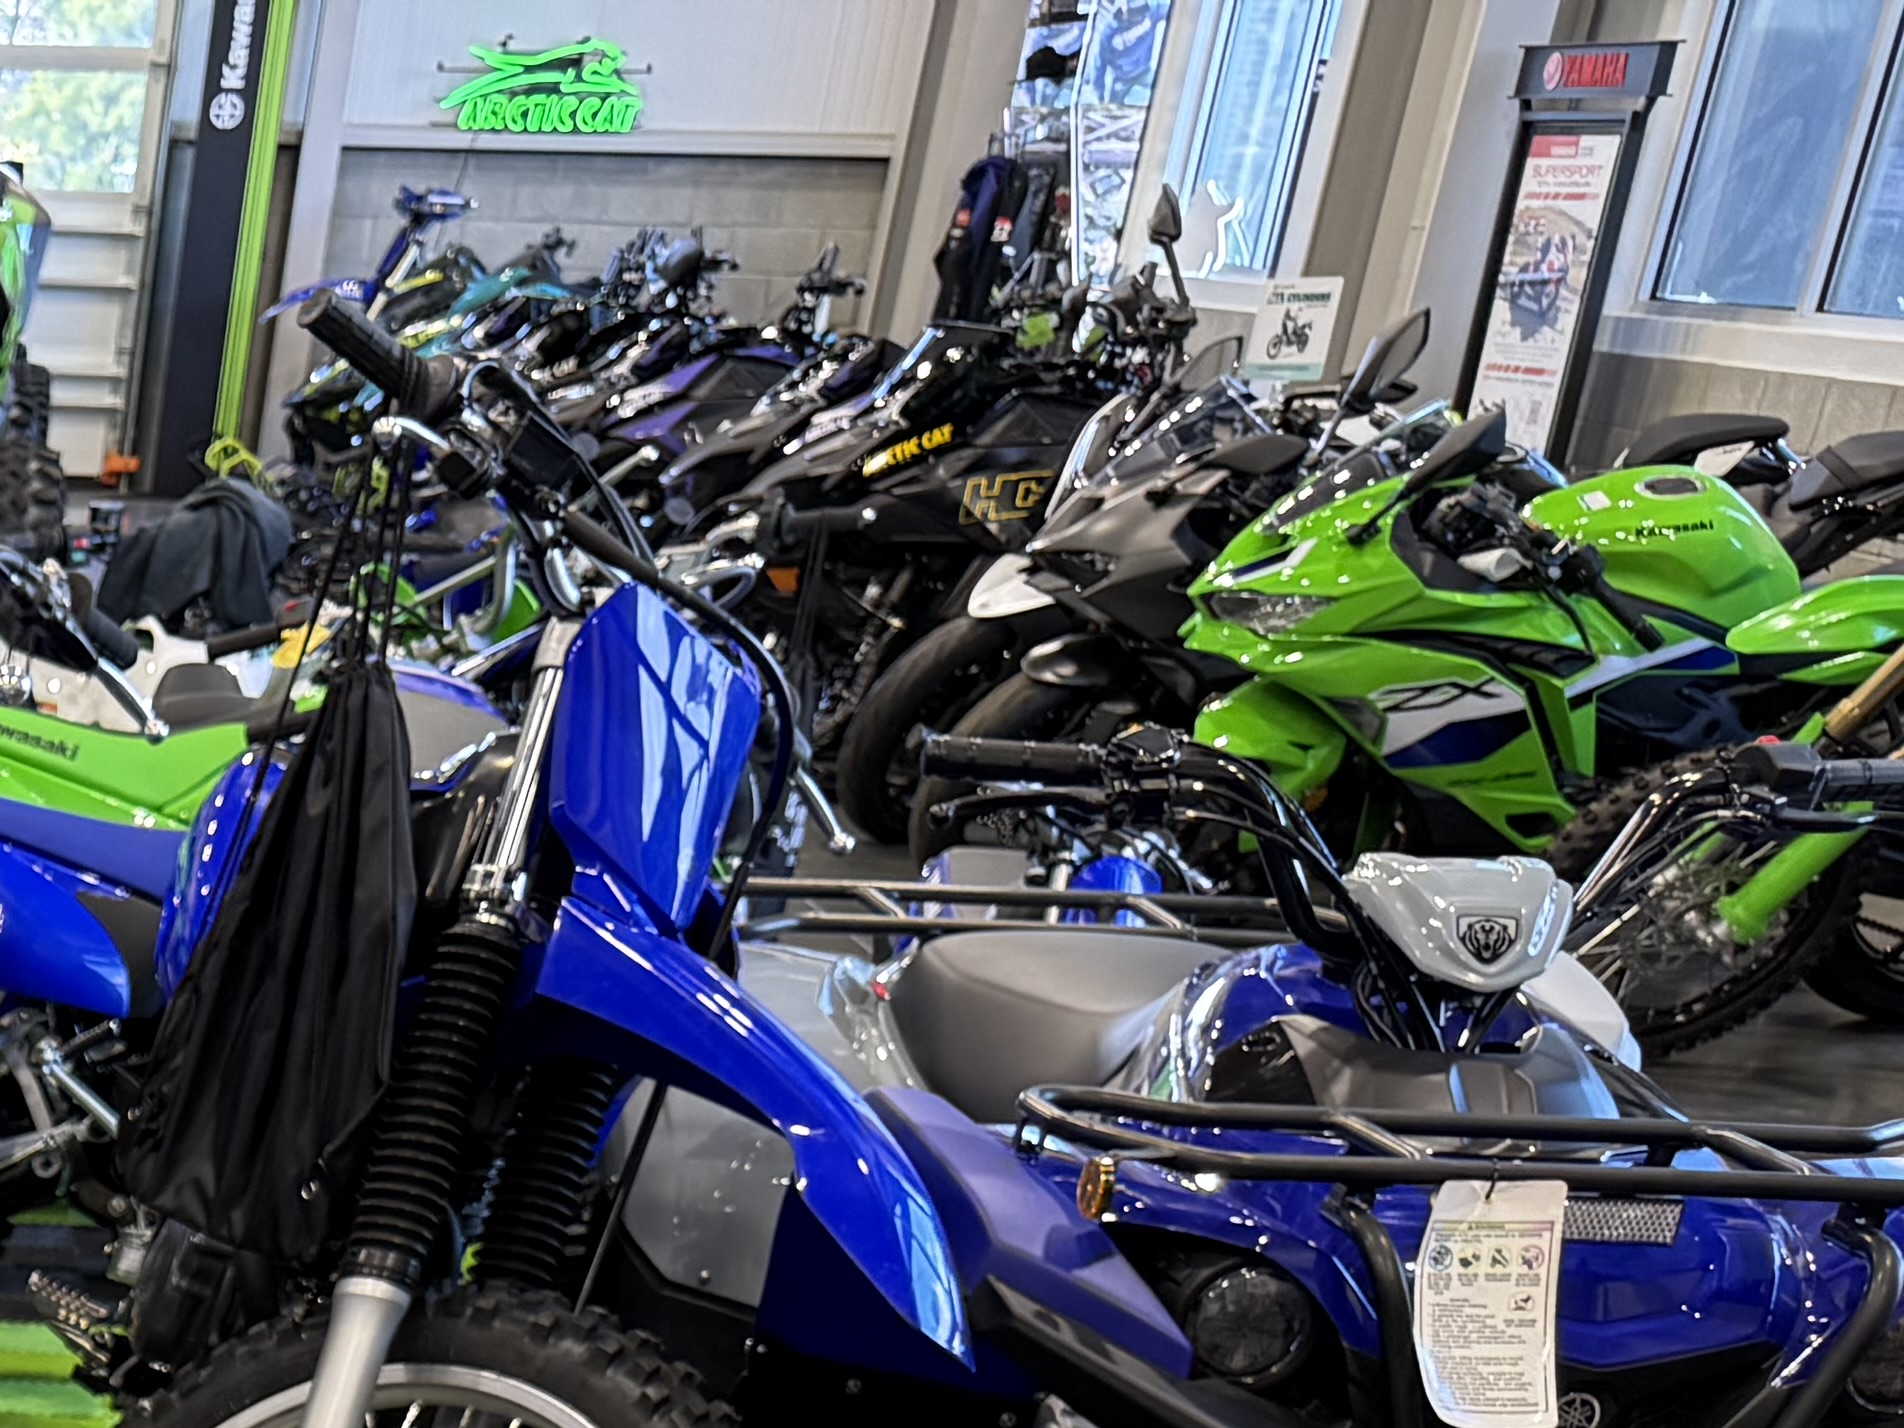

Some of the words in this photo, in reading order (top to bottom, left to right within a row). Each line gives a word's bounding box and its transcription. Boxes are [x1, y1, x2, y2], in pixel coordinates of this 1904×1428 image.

[220, 0, 255, 90] Kawa
[1563, 52, 1630, 88] YAMAHA
[456, 93, 578, 133] ARCTIC
[575, 95, 643, 133] CAT
